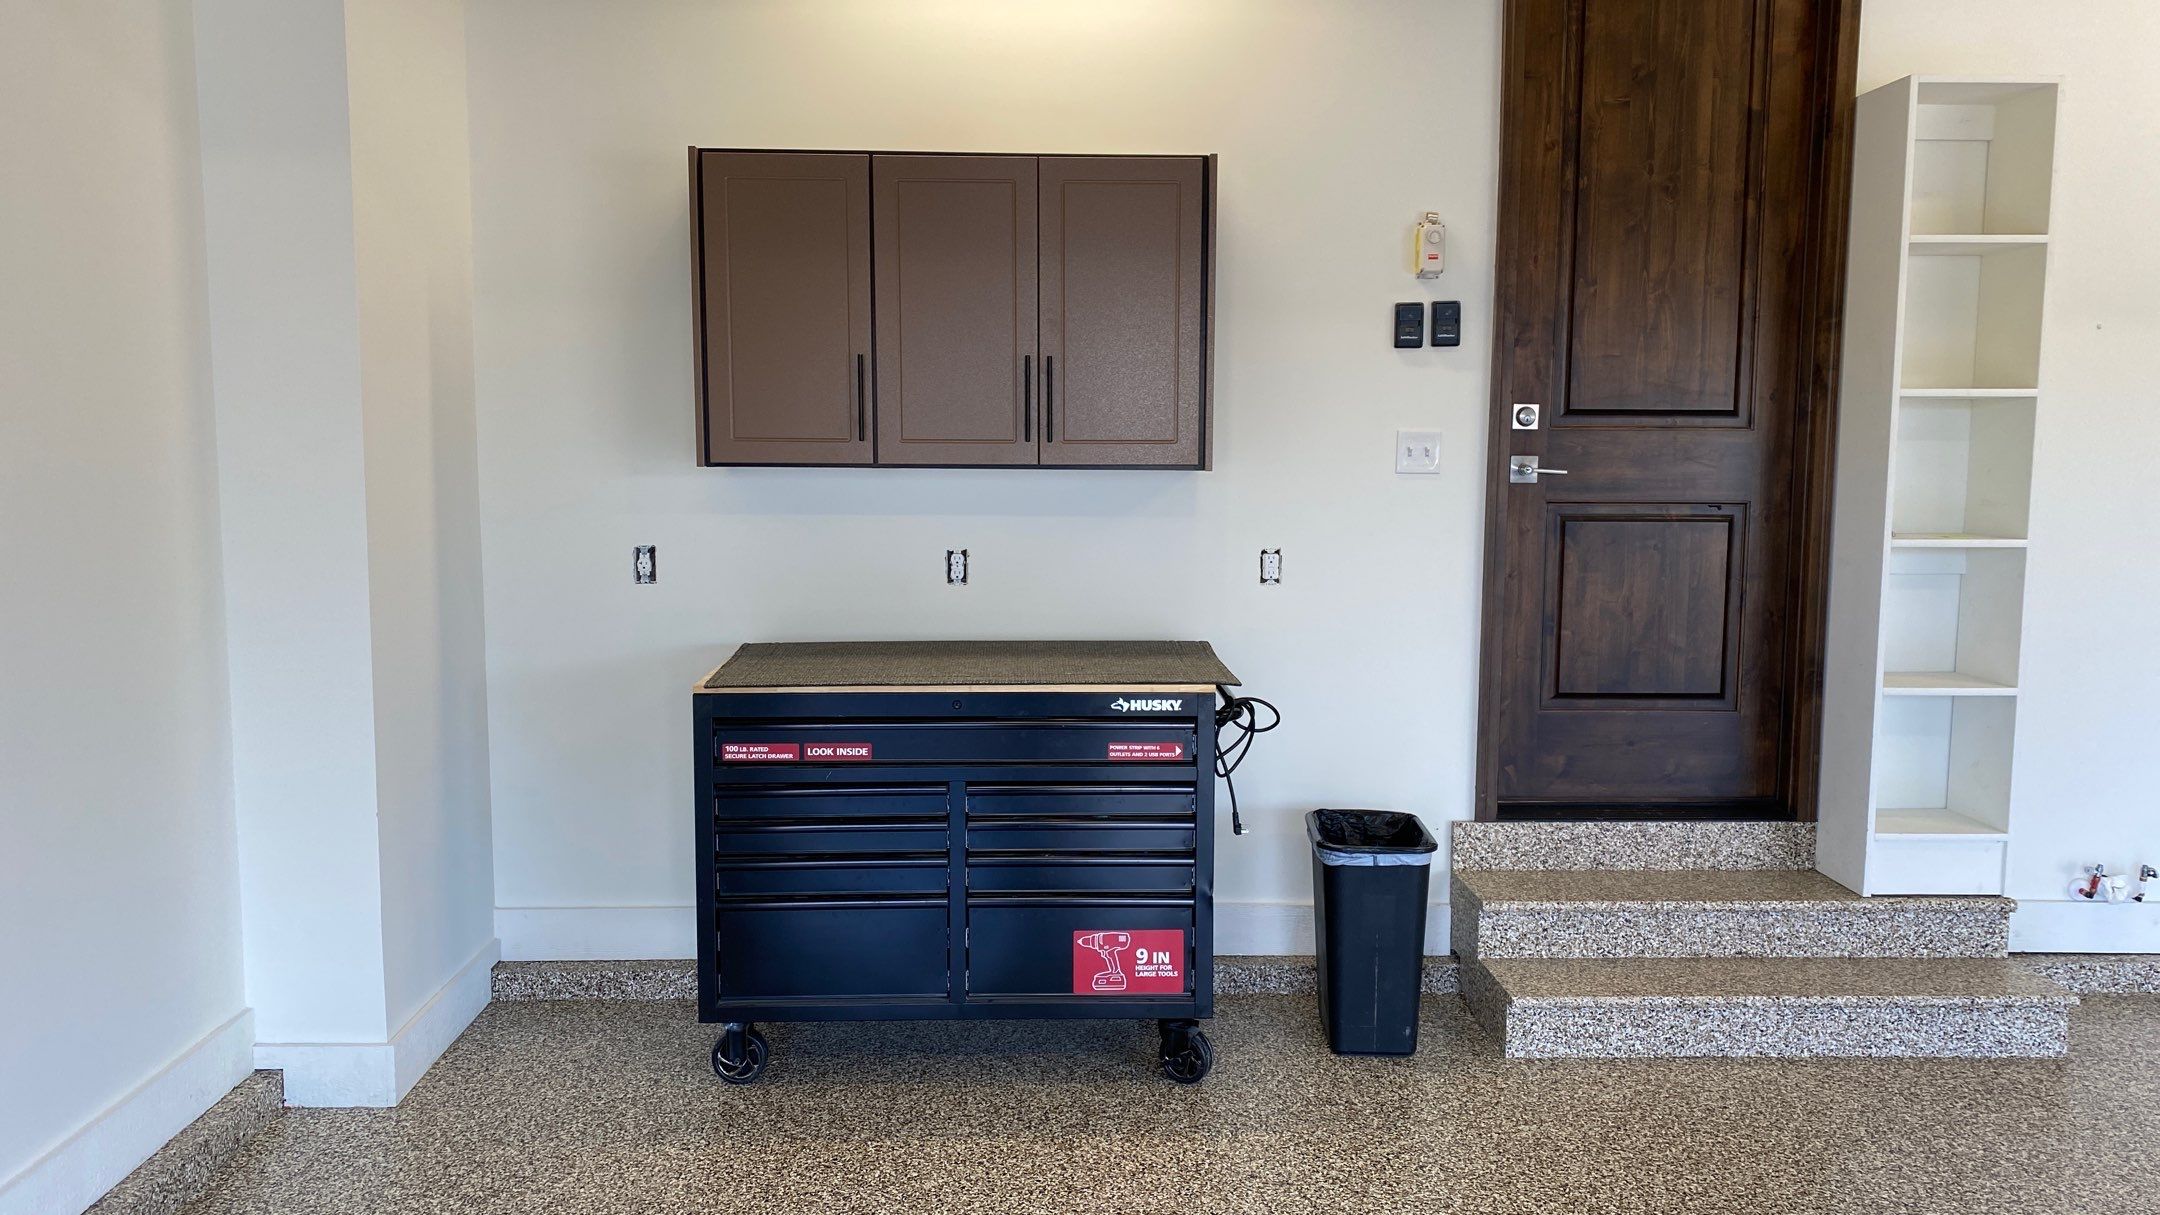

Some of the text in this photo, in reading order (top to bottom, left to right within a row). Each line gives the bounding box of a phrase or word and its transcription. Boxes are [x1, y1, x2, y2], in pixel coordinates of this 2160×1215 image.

[1130, 699, 1182, 711] HUSKY
[807, 747, 869, 756] LOOK INSIDE
[1135, 948, 1170, 964] 9 IN
